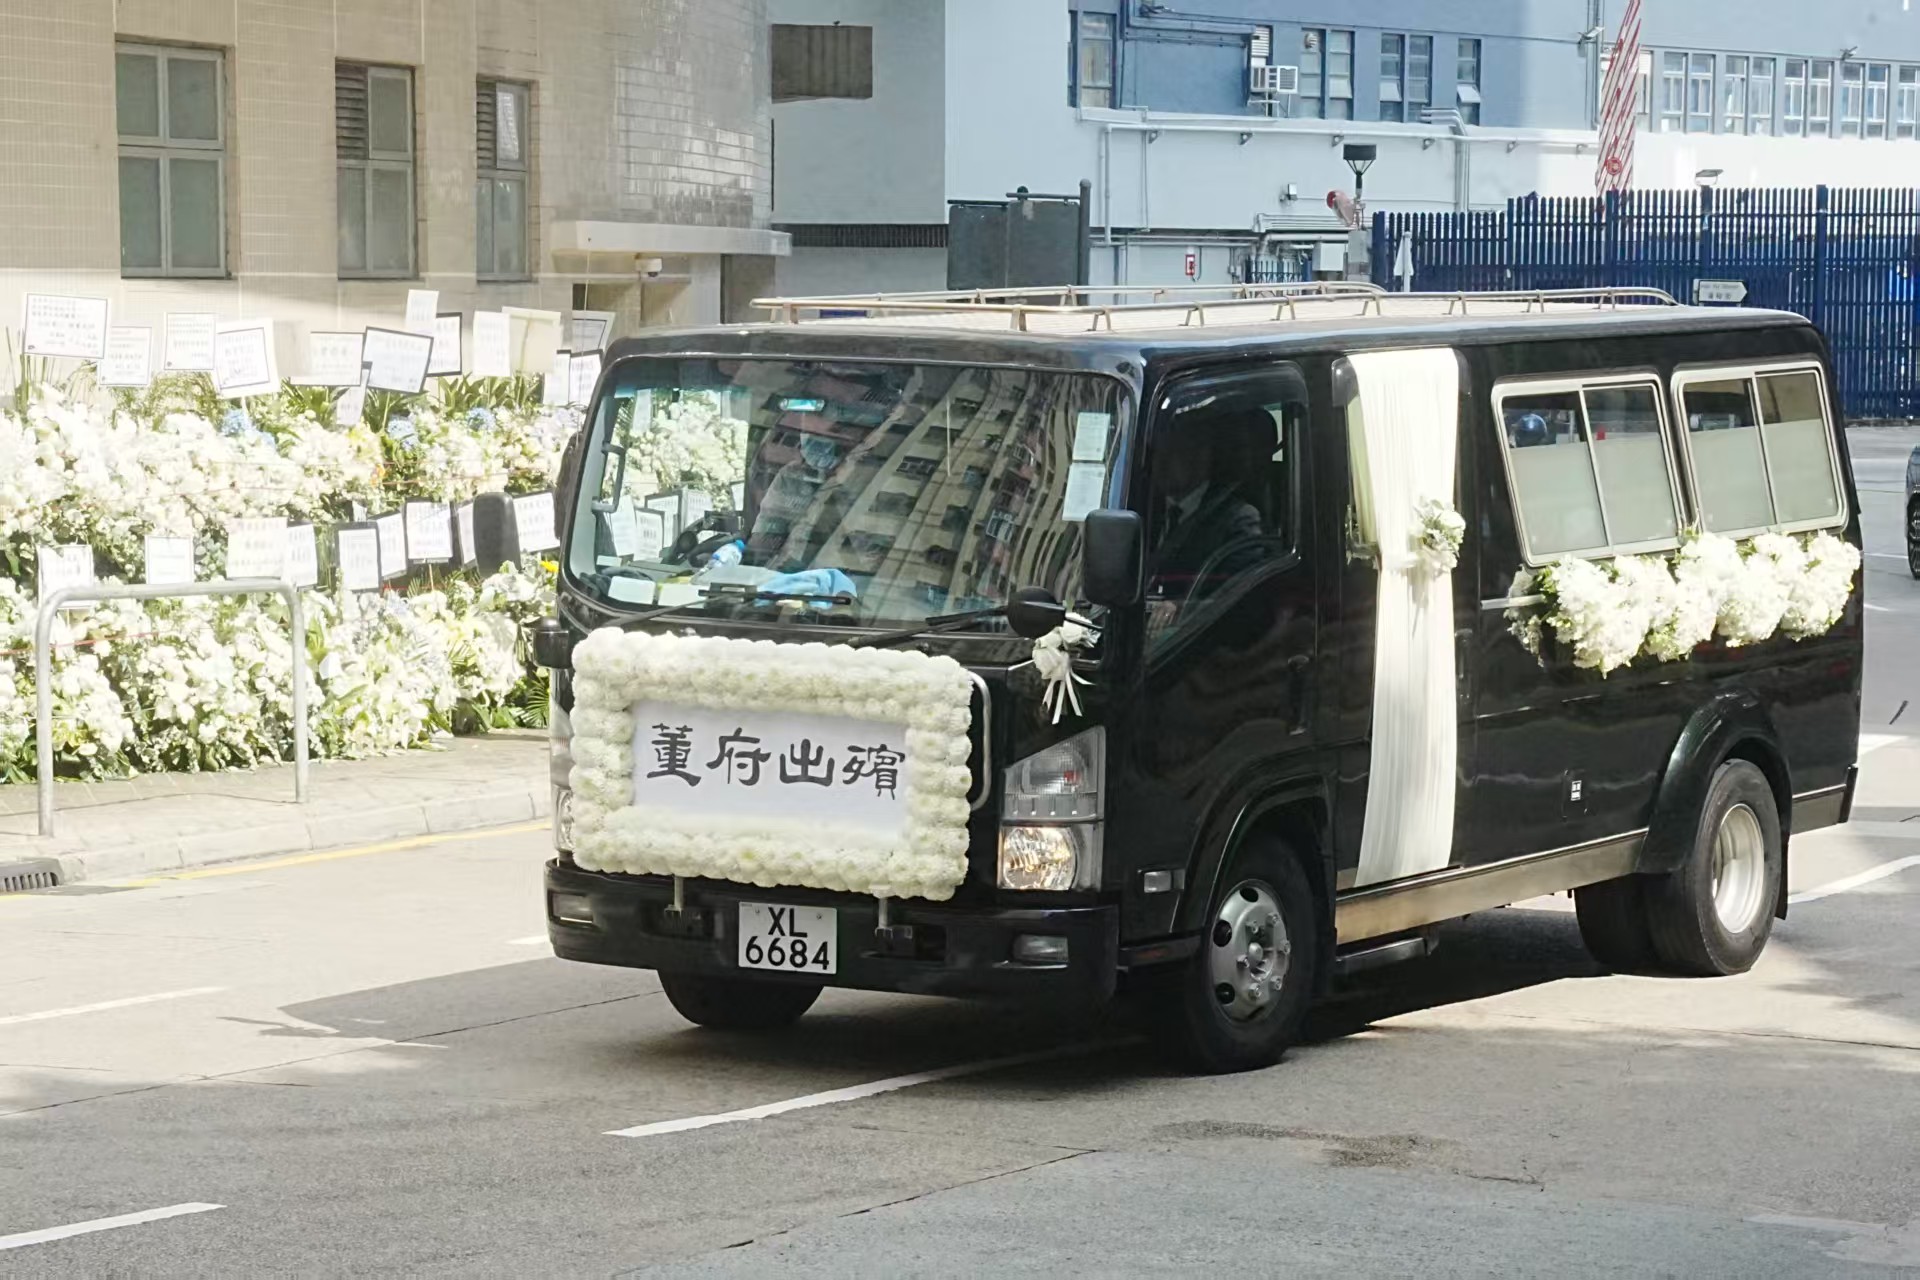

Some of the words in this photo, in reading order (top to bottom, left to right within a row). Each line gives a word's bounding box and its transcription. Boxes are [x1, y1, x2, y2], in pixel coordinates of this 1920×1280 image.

[646, 722, 906, 801] 董府出殯
[767, 906, 808, 938] XL
[745, 935, 830, 970] 6684
